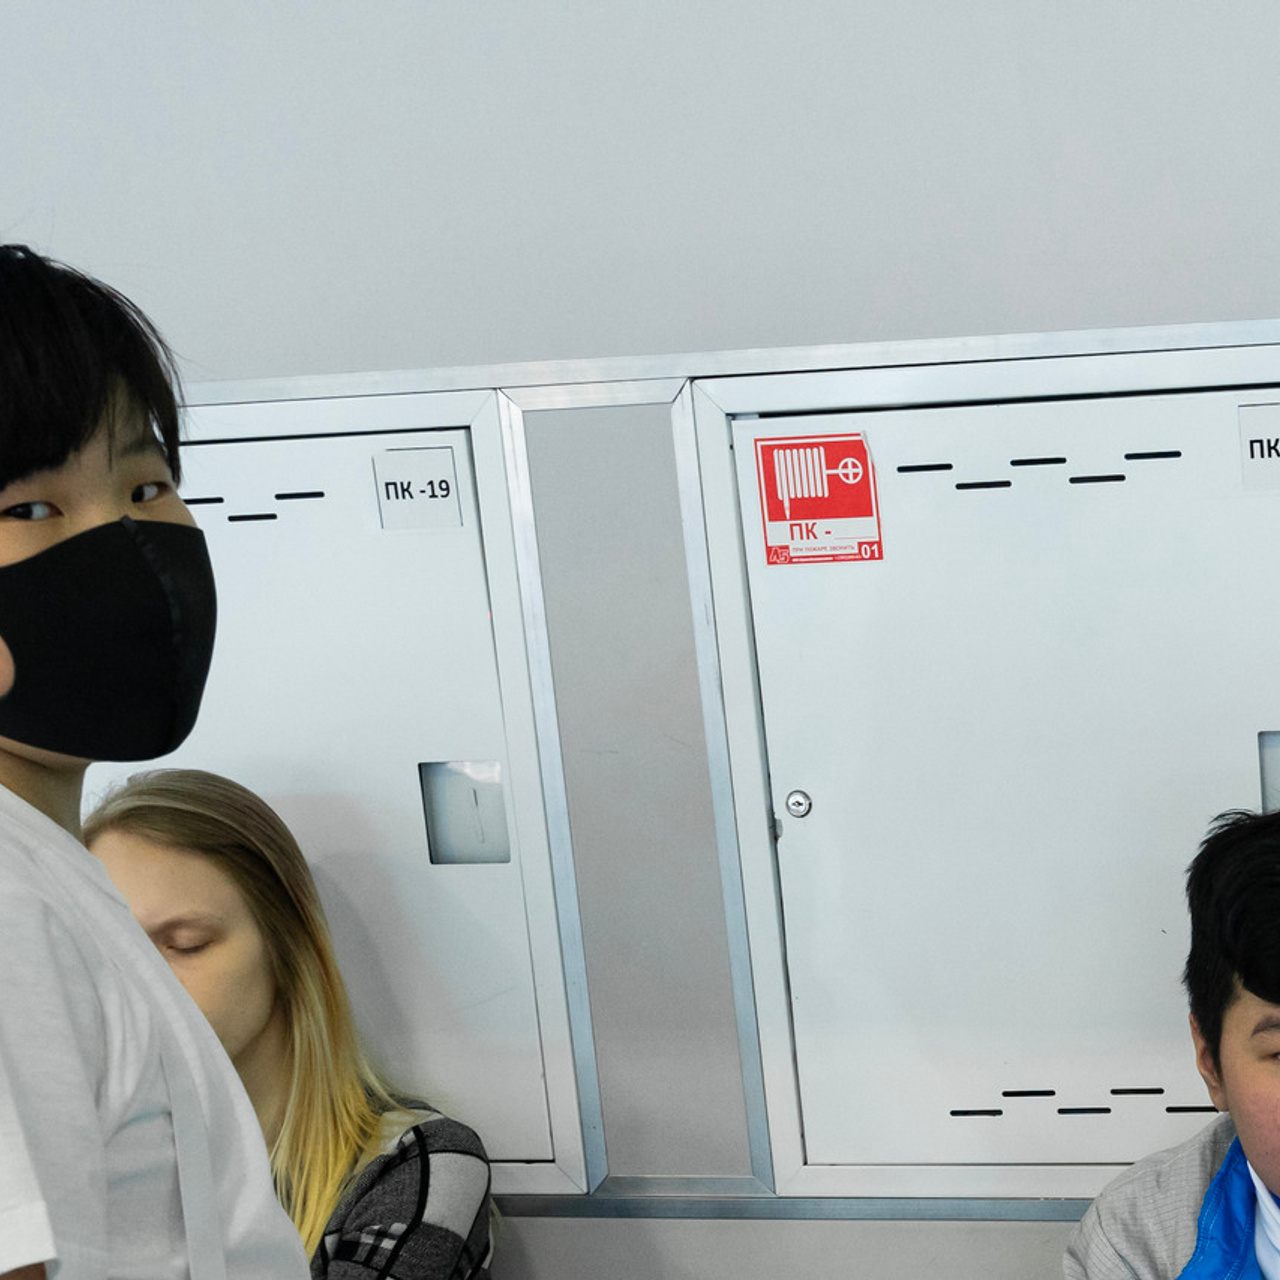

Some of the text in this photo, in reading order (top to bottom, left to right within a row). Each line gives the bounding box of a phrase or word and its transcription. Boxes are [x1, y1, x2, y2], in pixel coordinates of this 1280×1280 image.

[1249, 438, 1280, 459] ПК
[384, 479, 450, 500] ПК -19
[789, 522, 818, 541] ПК
[861, 544, 879, 558] 01
